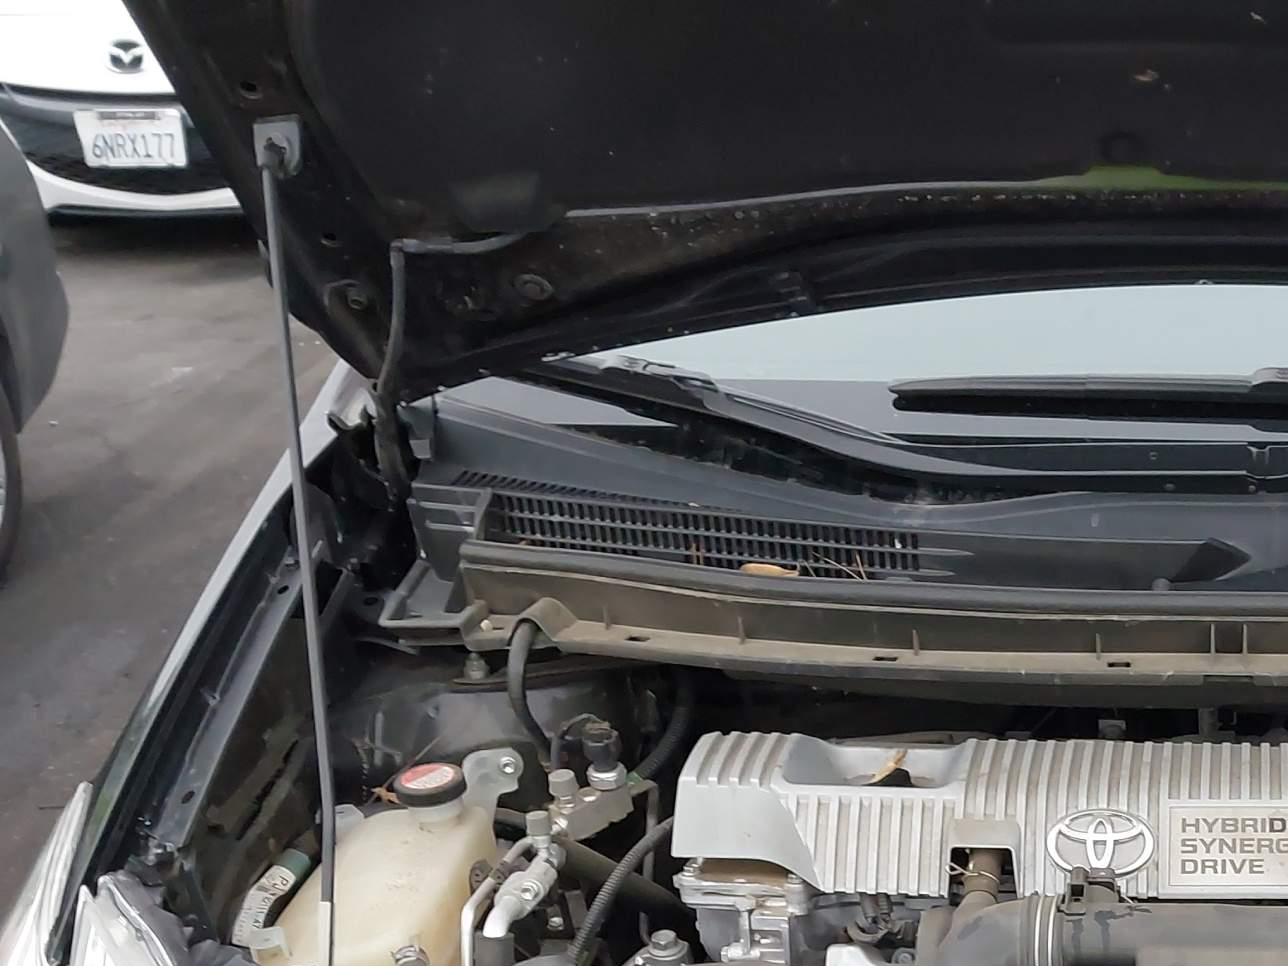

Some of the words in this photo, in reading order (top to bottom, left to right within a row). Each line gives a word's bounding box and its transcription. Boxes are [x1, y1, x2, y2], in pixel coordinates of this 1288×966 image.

[92, 133, 175, 158] 6NRX177
[1180, 817, 1287, 833] HYBRID
[1180, 858, 1265, 875] DRIVE
